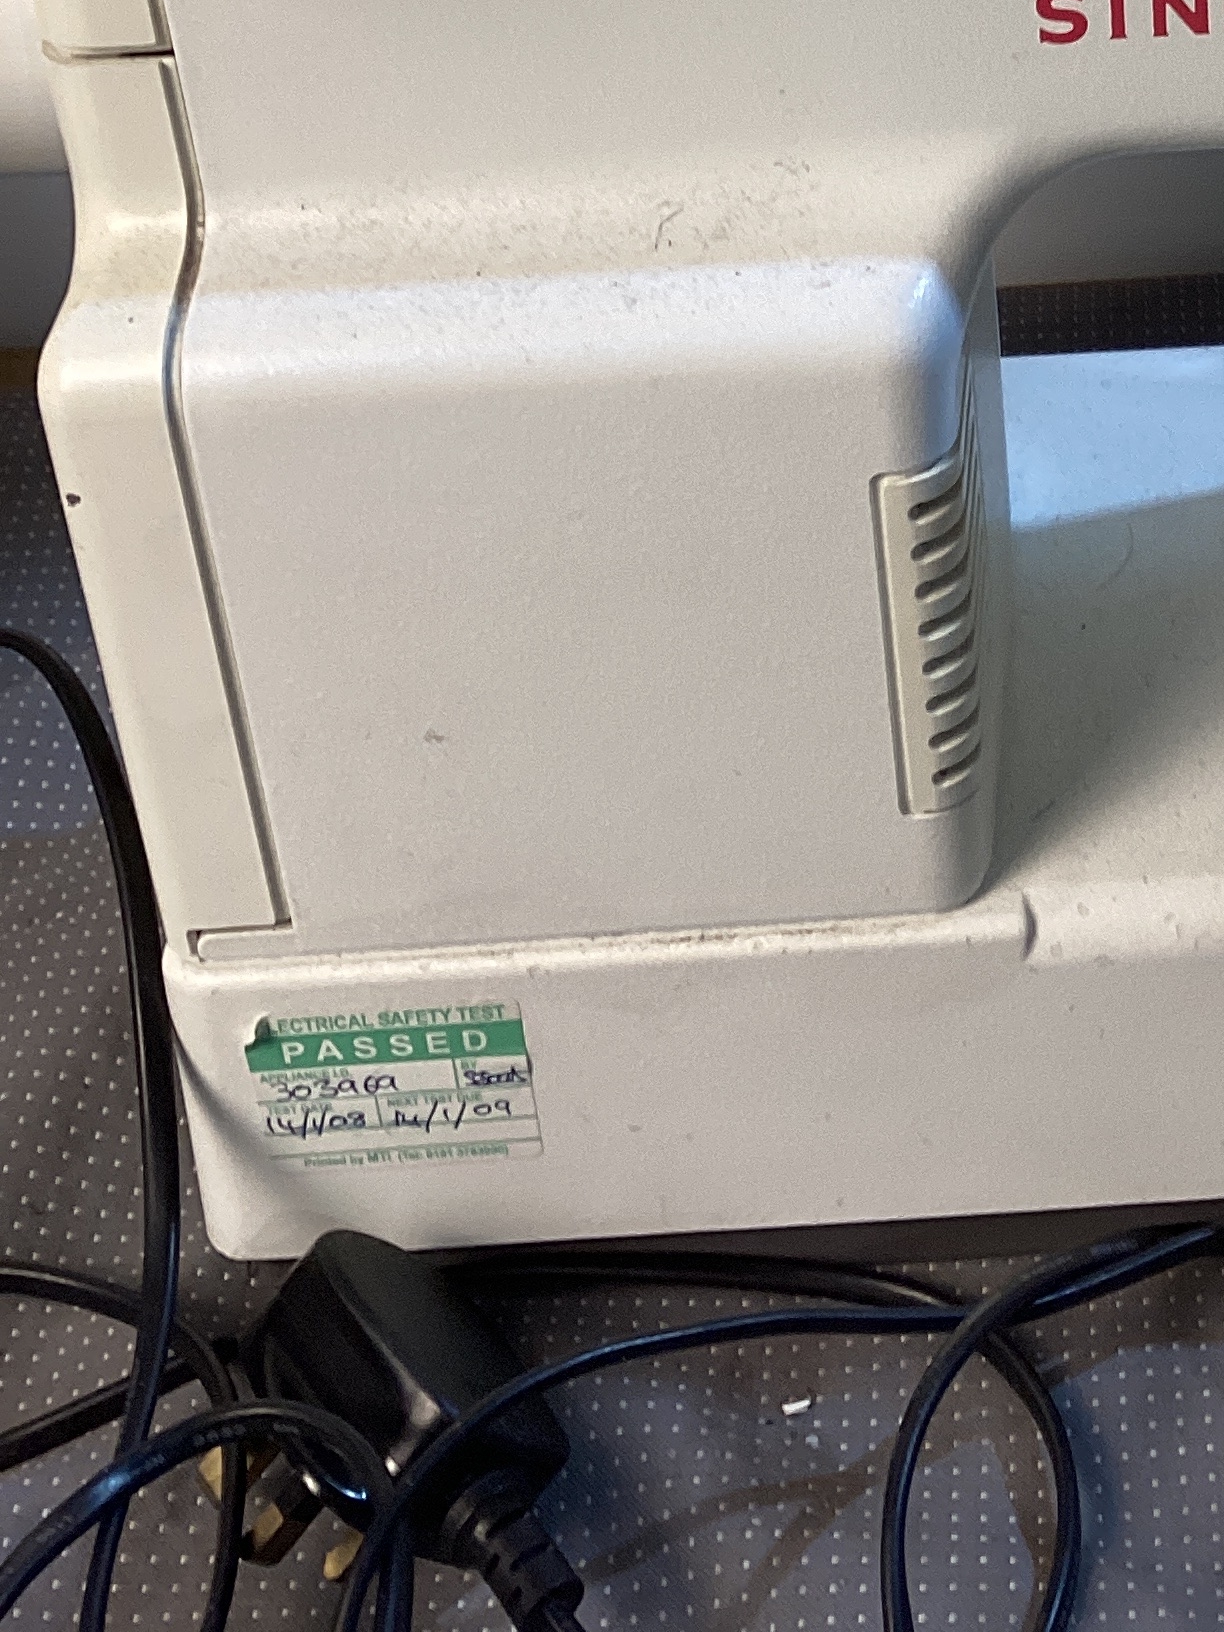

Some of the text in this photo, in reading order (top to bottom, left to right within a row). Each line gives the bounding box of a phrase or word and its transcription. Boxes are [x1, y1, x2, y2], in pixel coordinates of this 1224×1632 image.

[378, 1005, 452, 1026] SAFETY
[456, 1003, 505, 1023] TEST
[281, 1028, 488, 1065] PASSED
